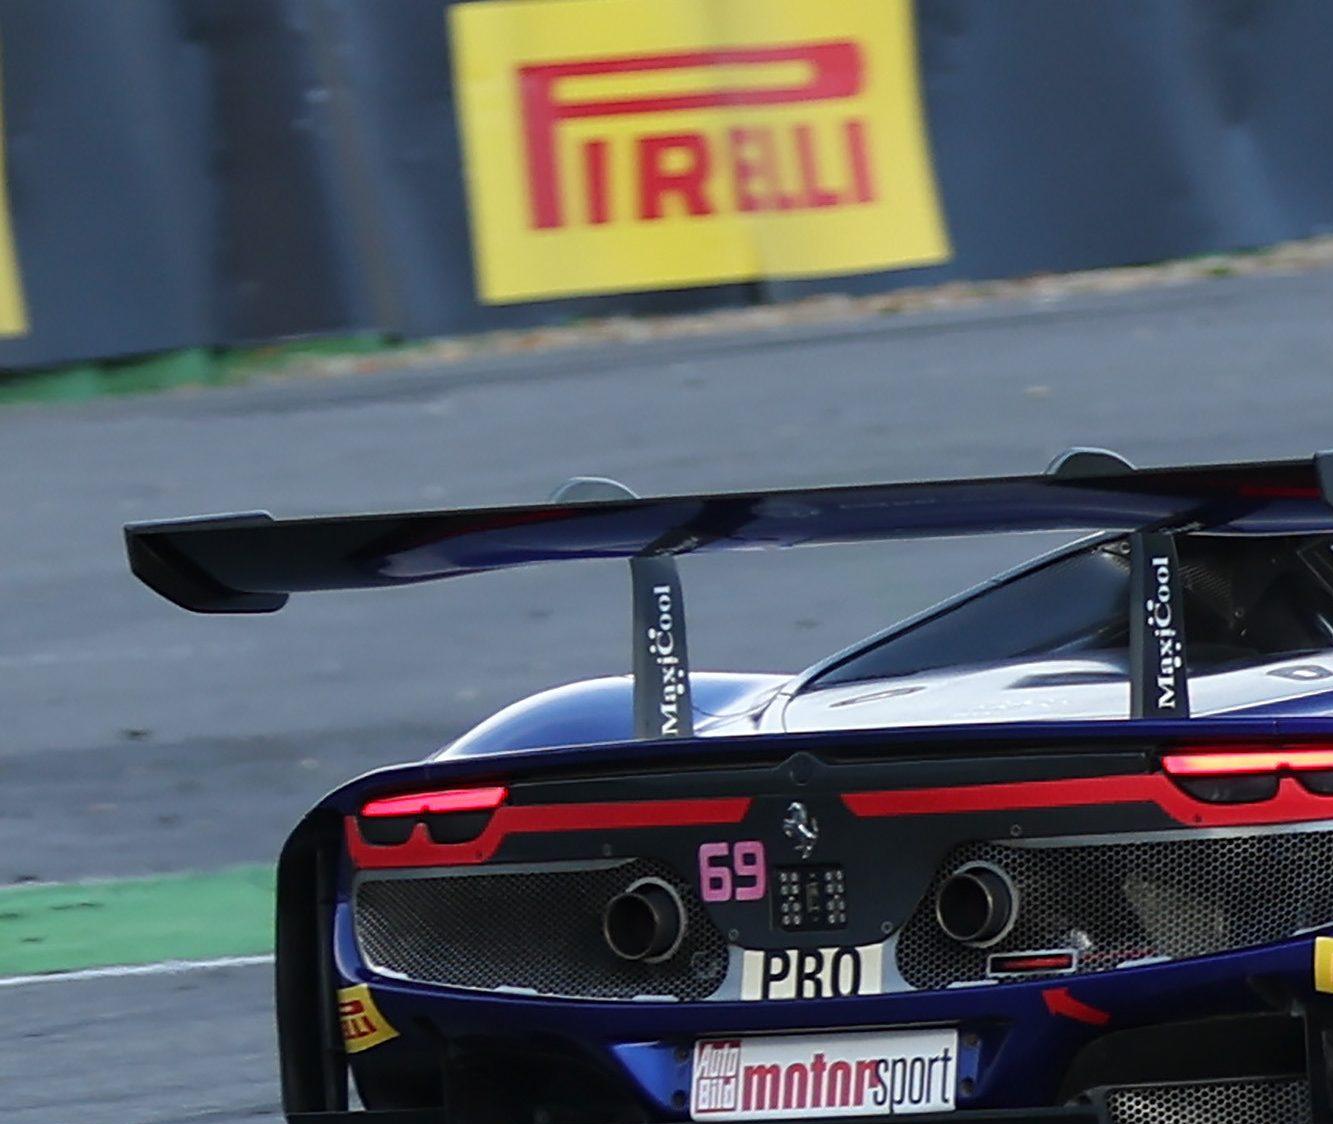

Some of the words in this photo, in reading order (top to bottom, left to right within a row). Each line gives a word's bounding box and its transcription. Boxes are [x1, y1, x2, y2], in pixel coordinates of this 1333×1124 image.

[518, 38, 874, 231] PIRELLI
[650, 585, 683, 735] MaxiCool
[1149, 557, 1181, 709] MaxiCool
[699, 841, 766, 902] 69
[762, 947, 861, 1000] PRO
[697, 1077, 738, 1110] Bild
